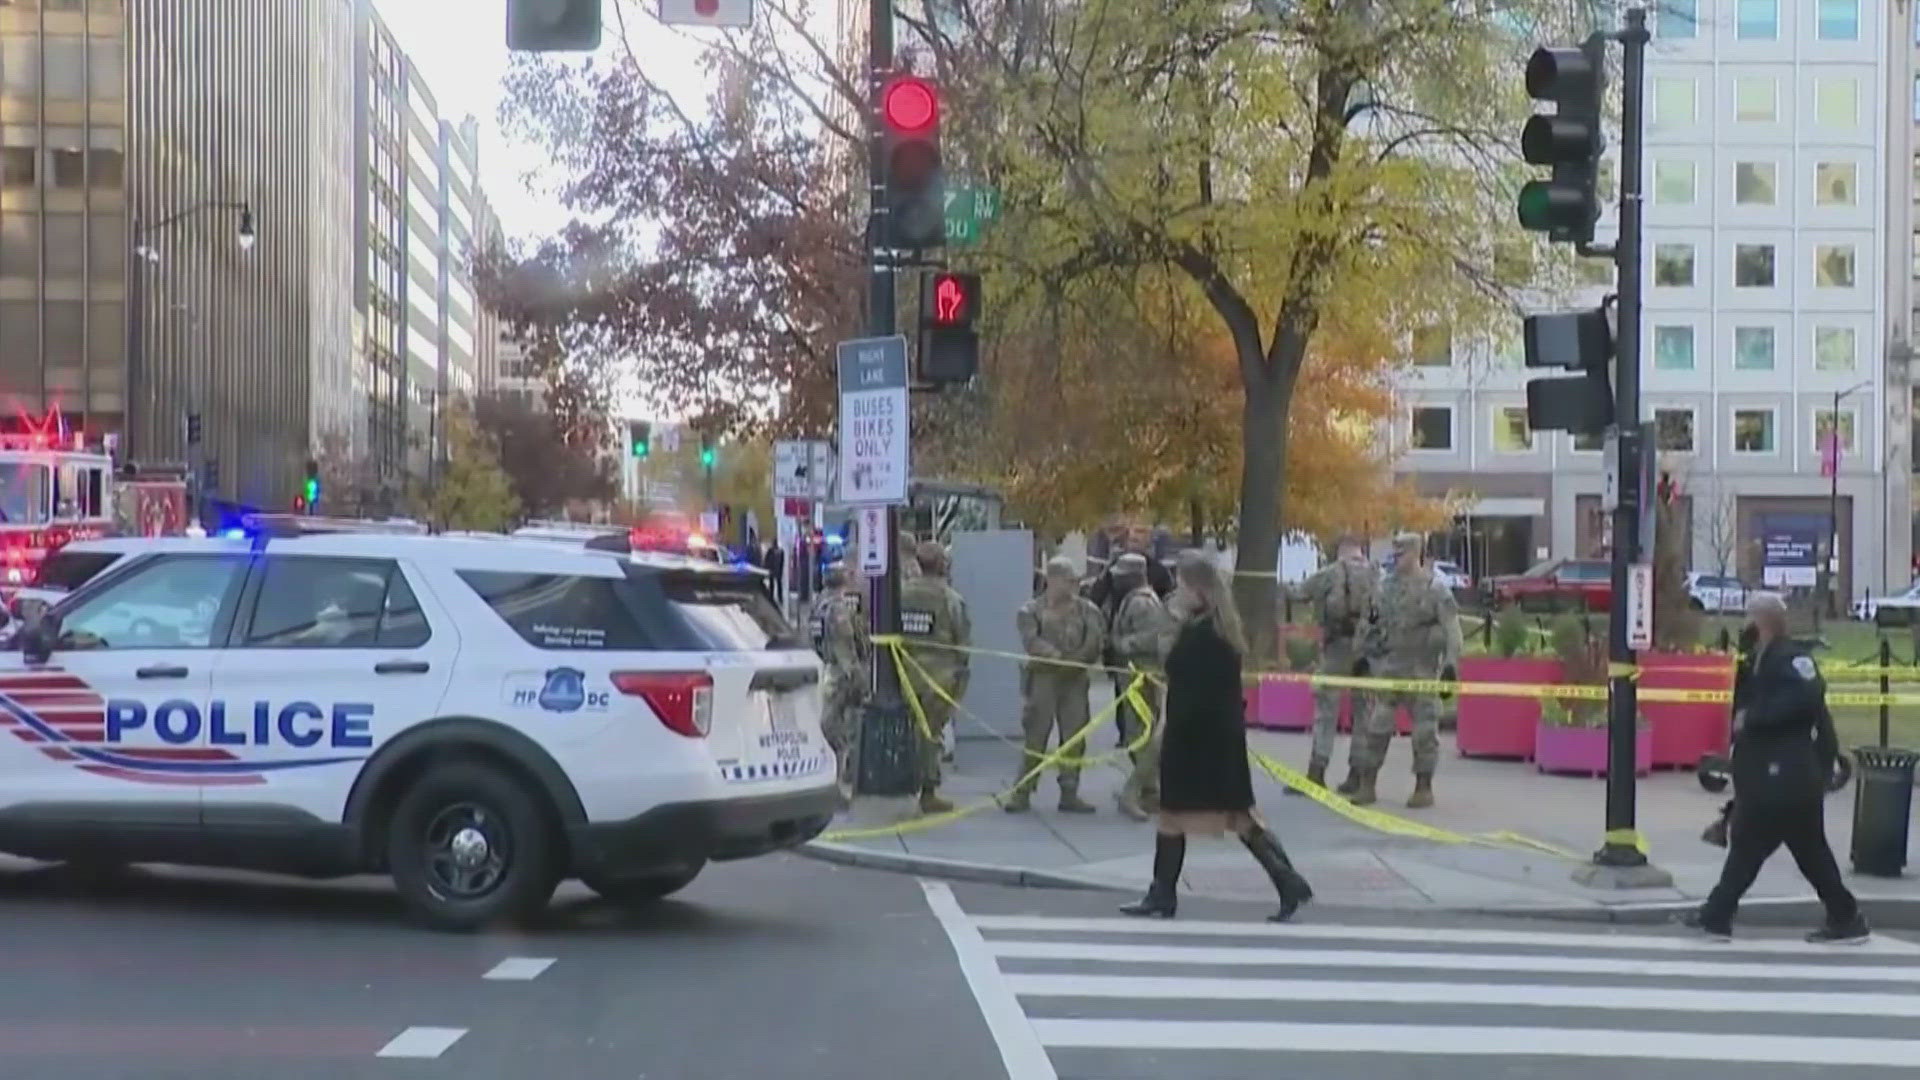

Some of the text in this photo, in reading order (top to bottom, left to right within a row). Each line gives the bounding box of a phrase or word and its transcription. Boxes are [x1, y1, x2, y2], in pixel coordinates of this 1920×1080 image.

[860, 368, 884, 385] LANE
[853, 396, 893, 417] BUSES
[853, 418, 894, 438] BIKES
[855, 438, 891, 457] ONLY
[513, 690, 609, 706] MP DC
[106, 698, 374, 748] POLICE
